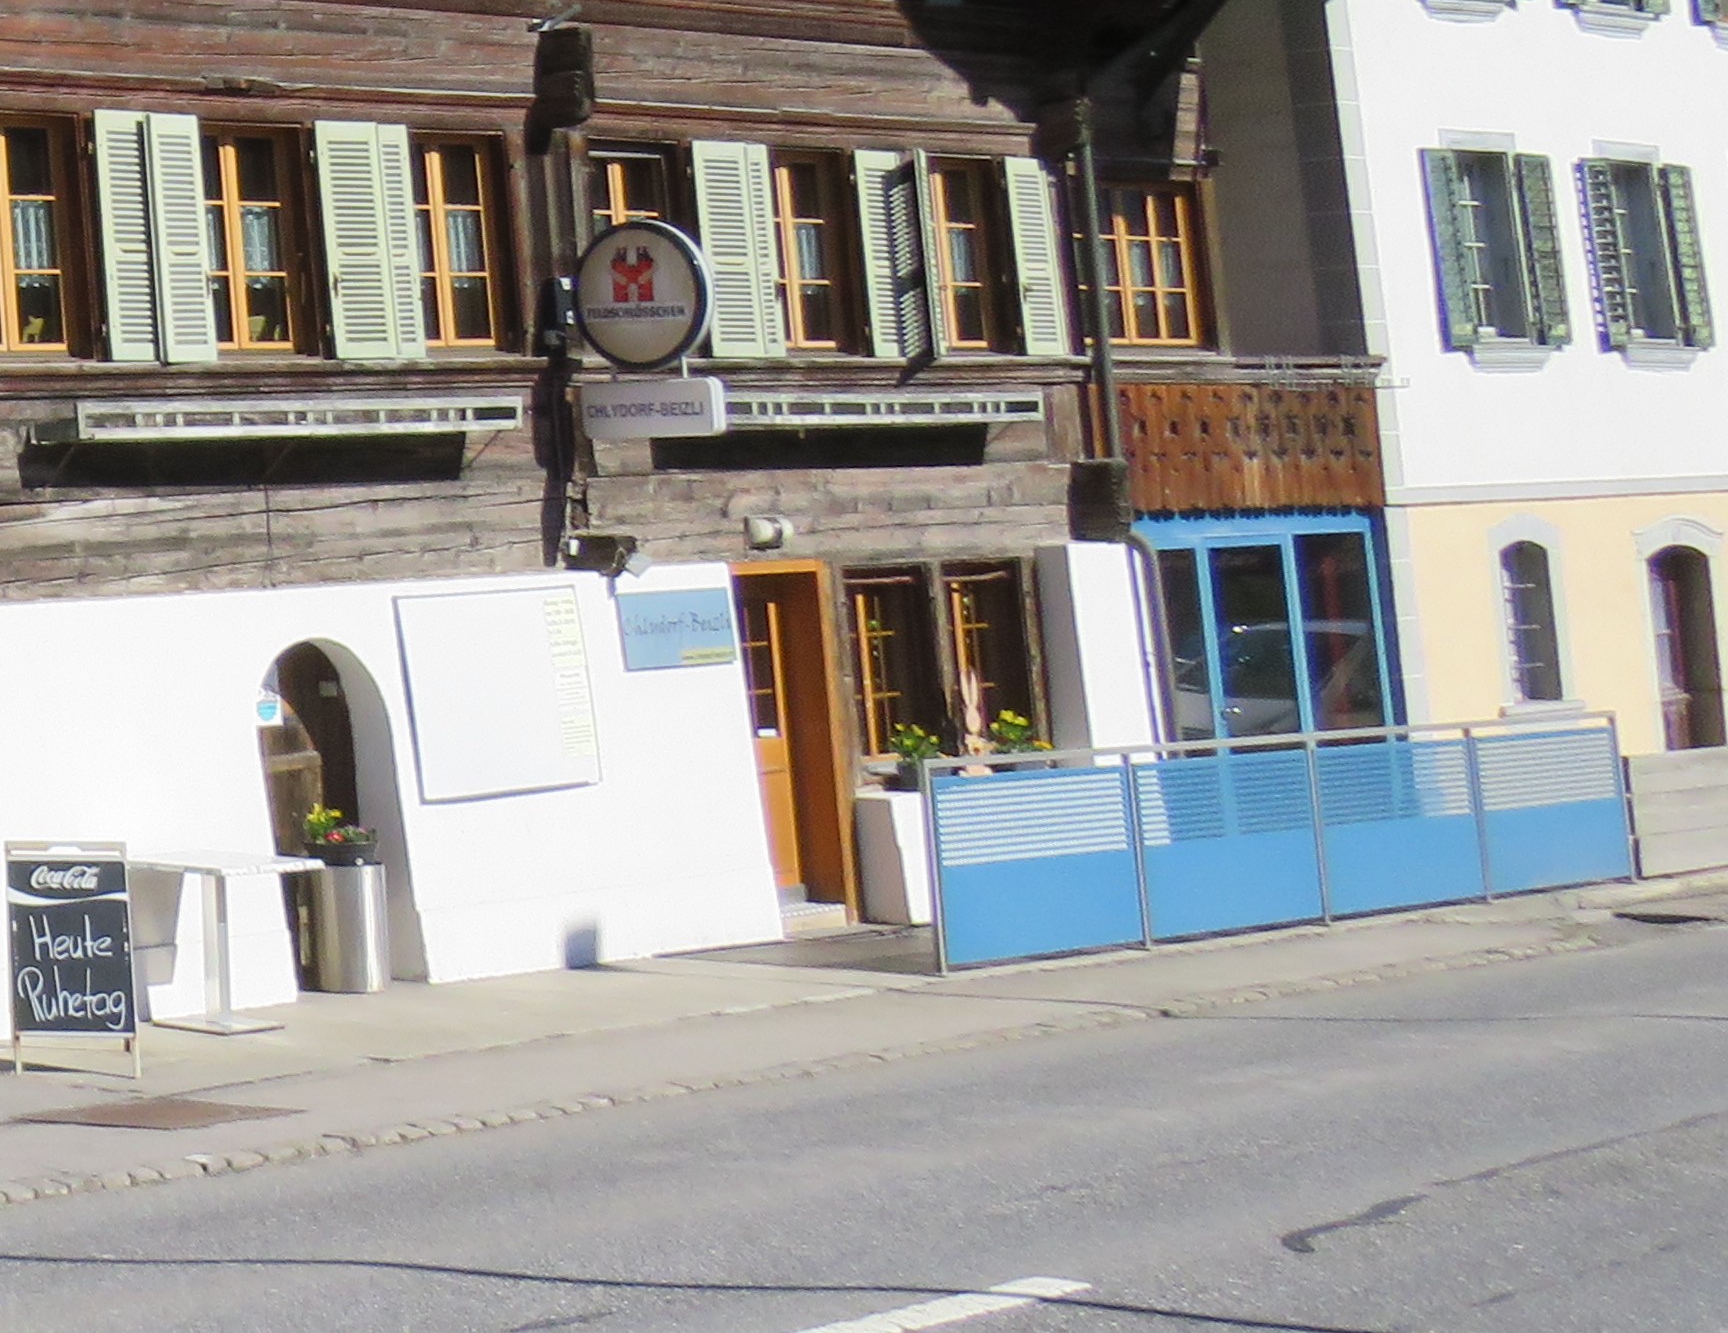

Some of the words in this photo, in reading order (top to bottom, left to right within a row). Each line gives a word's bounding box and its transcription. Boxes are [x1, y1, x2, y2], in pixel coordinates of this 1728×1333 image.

[587, 401, 704, 418] CHLYDORF-BEIZLI
[29, 914, 113, 961] Heute
[17, 965, 126, 1030] Ruhetag
